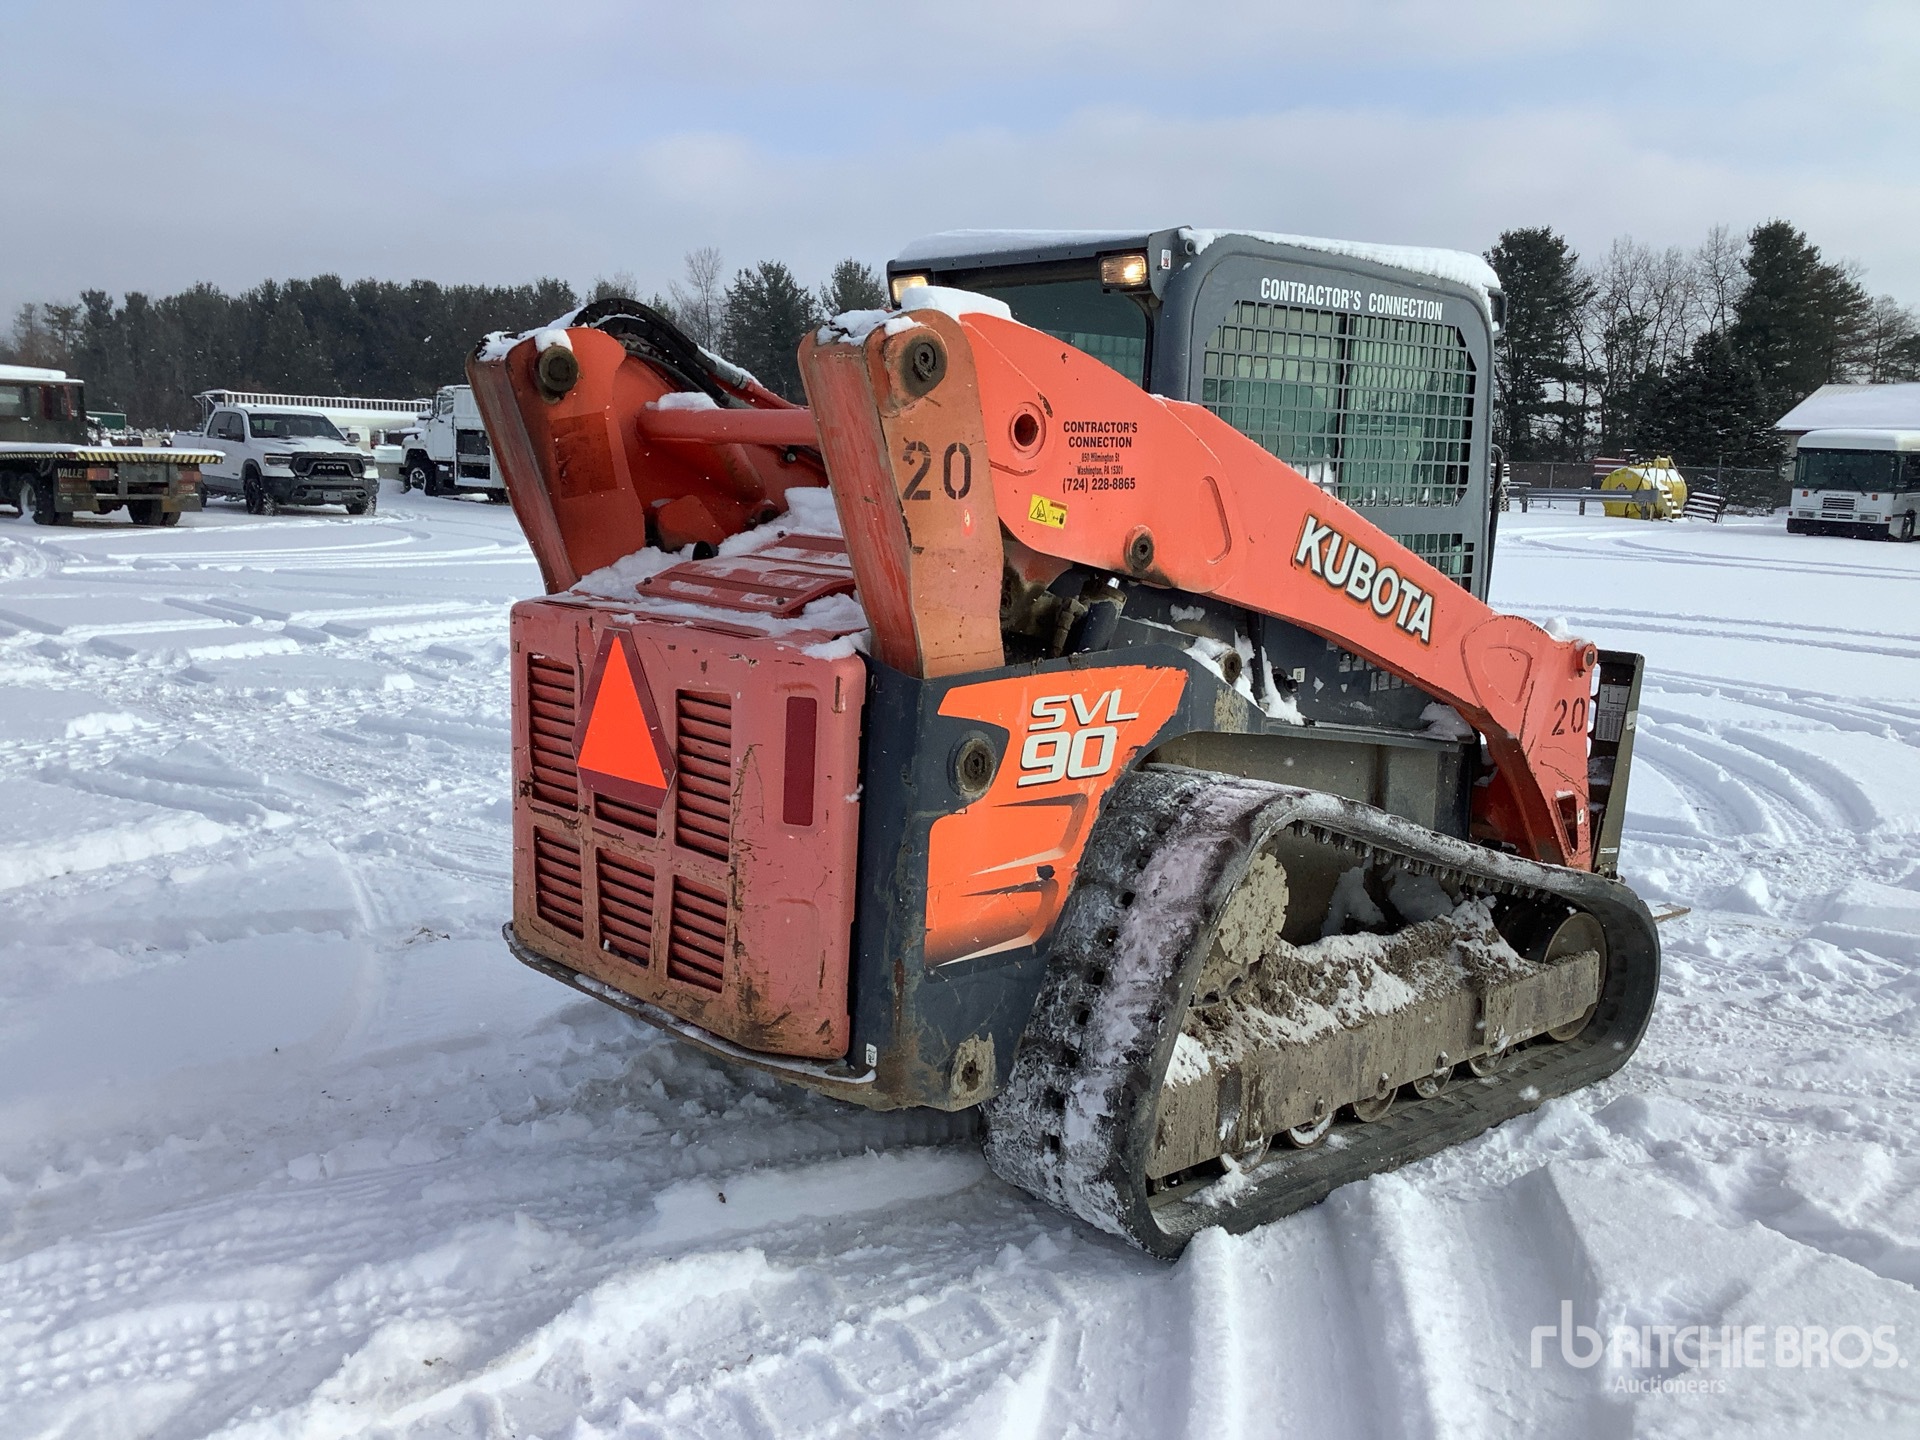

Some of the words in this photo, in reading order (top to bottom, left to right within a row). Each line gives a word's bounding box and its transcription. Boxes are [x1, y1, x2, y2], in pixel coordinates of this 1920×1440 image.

[1260, 277, 1362, 311] CONTRACTOR'S
[1368, 292, 1444, 321] CONNECTION
[1063, 421, 1138, 433] CONTRACTOR'S
[1068, 436, 1132, 448] CONNECTION
[57, 467, 87, 479] VALLE
[902, 440, 972, 501] 20
[1062, 477, 1089, 494] (724)
[1091, 477, 1136, 491] 228-8865
[1104, 465, 1110, 475] PA
[1295, 514, 1434, 644] KUBOTA
[1027, 688, 1140, 732] SVL
[1551, 696, 1586, 737] 20
[1017, 725, 1118, 789] 90
